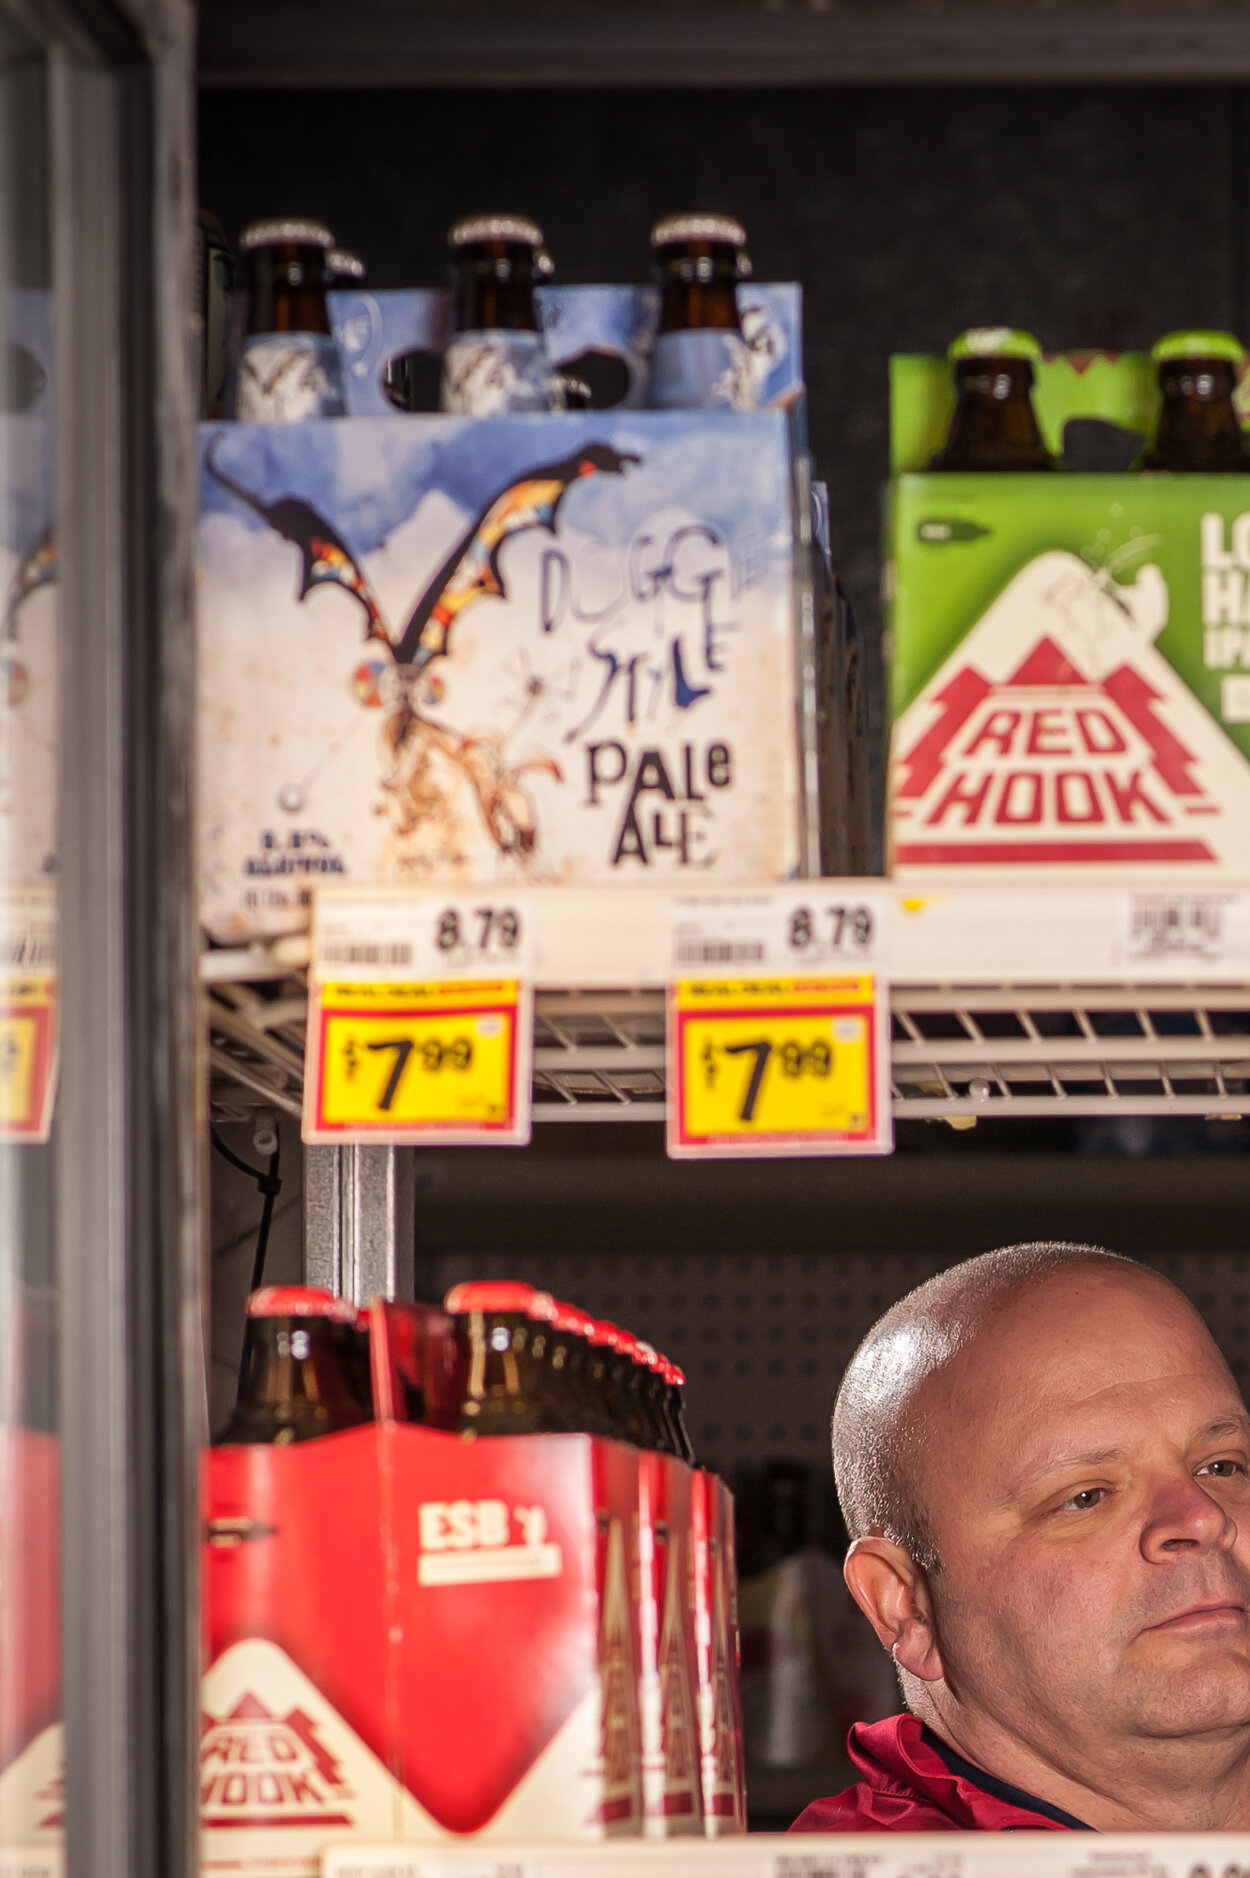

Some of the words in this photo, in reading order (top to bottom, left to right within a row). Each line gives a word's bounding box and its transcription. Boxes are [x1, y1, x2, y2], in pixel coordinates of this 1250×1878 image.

[962, 707, 1128, 757] RED
[924, 769, 1171, 826] HOOK
[609, 801, 720, 868] ALE
[437, 907, 520, 951] 8.79
[789, 905, 873, 949] 8.79
[417, 1500, 510, 1551] ESB
